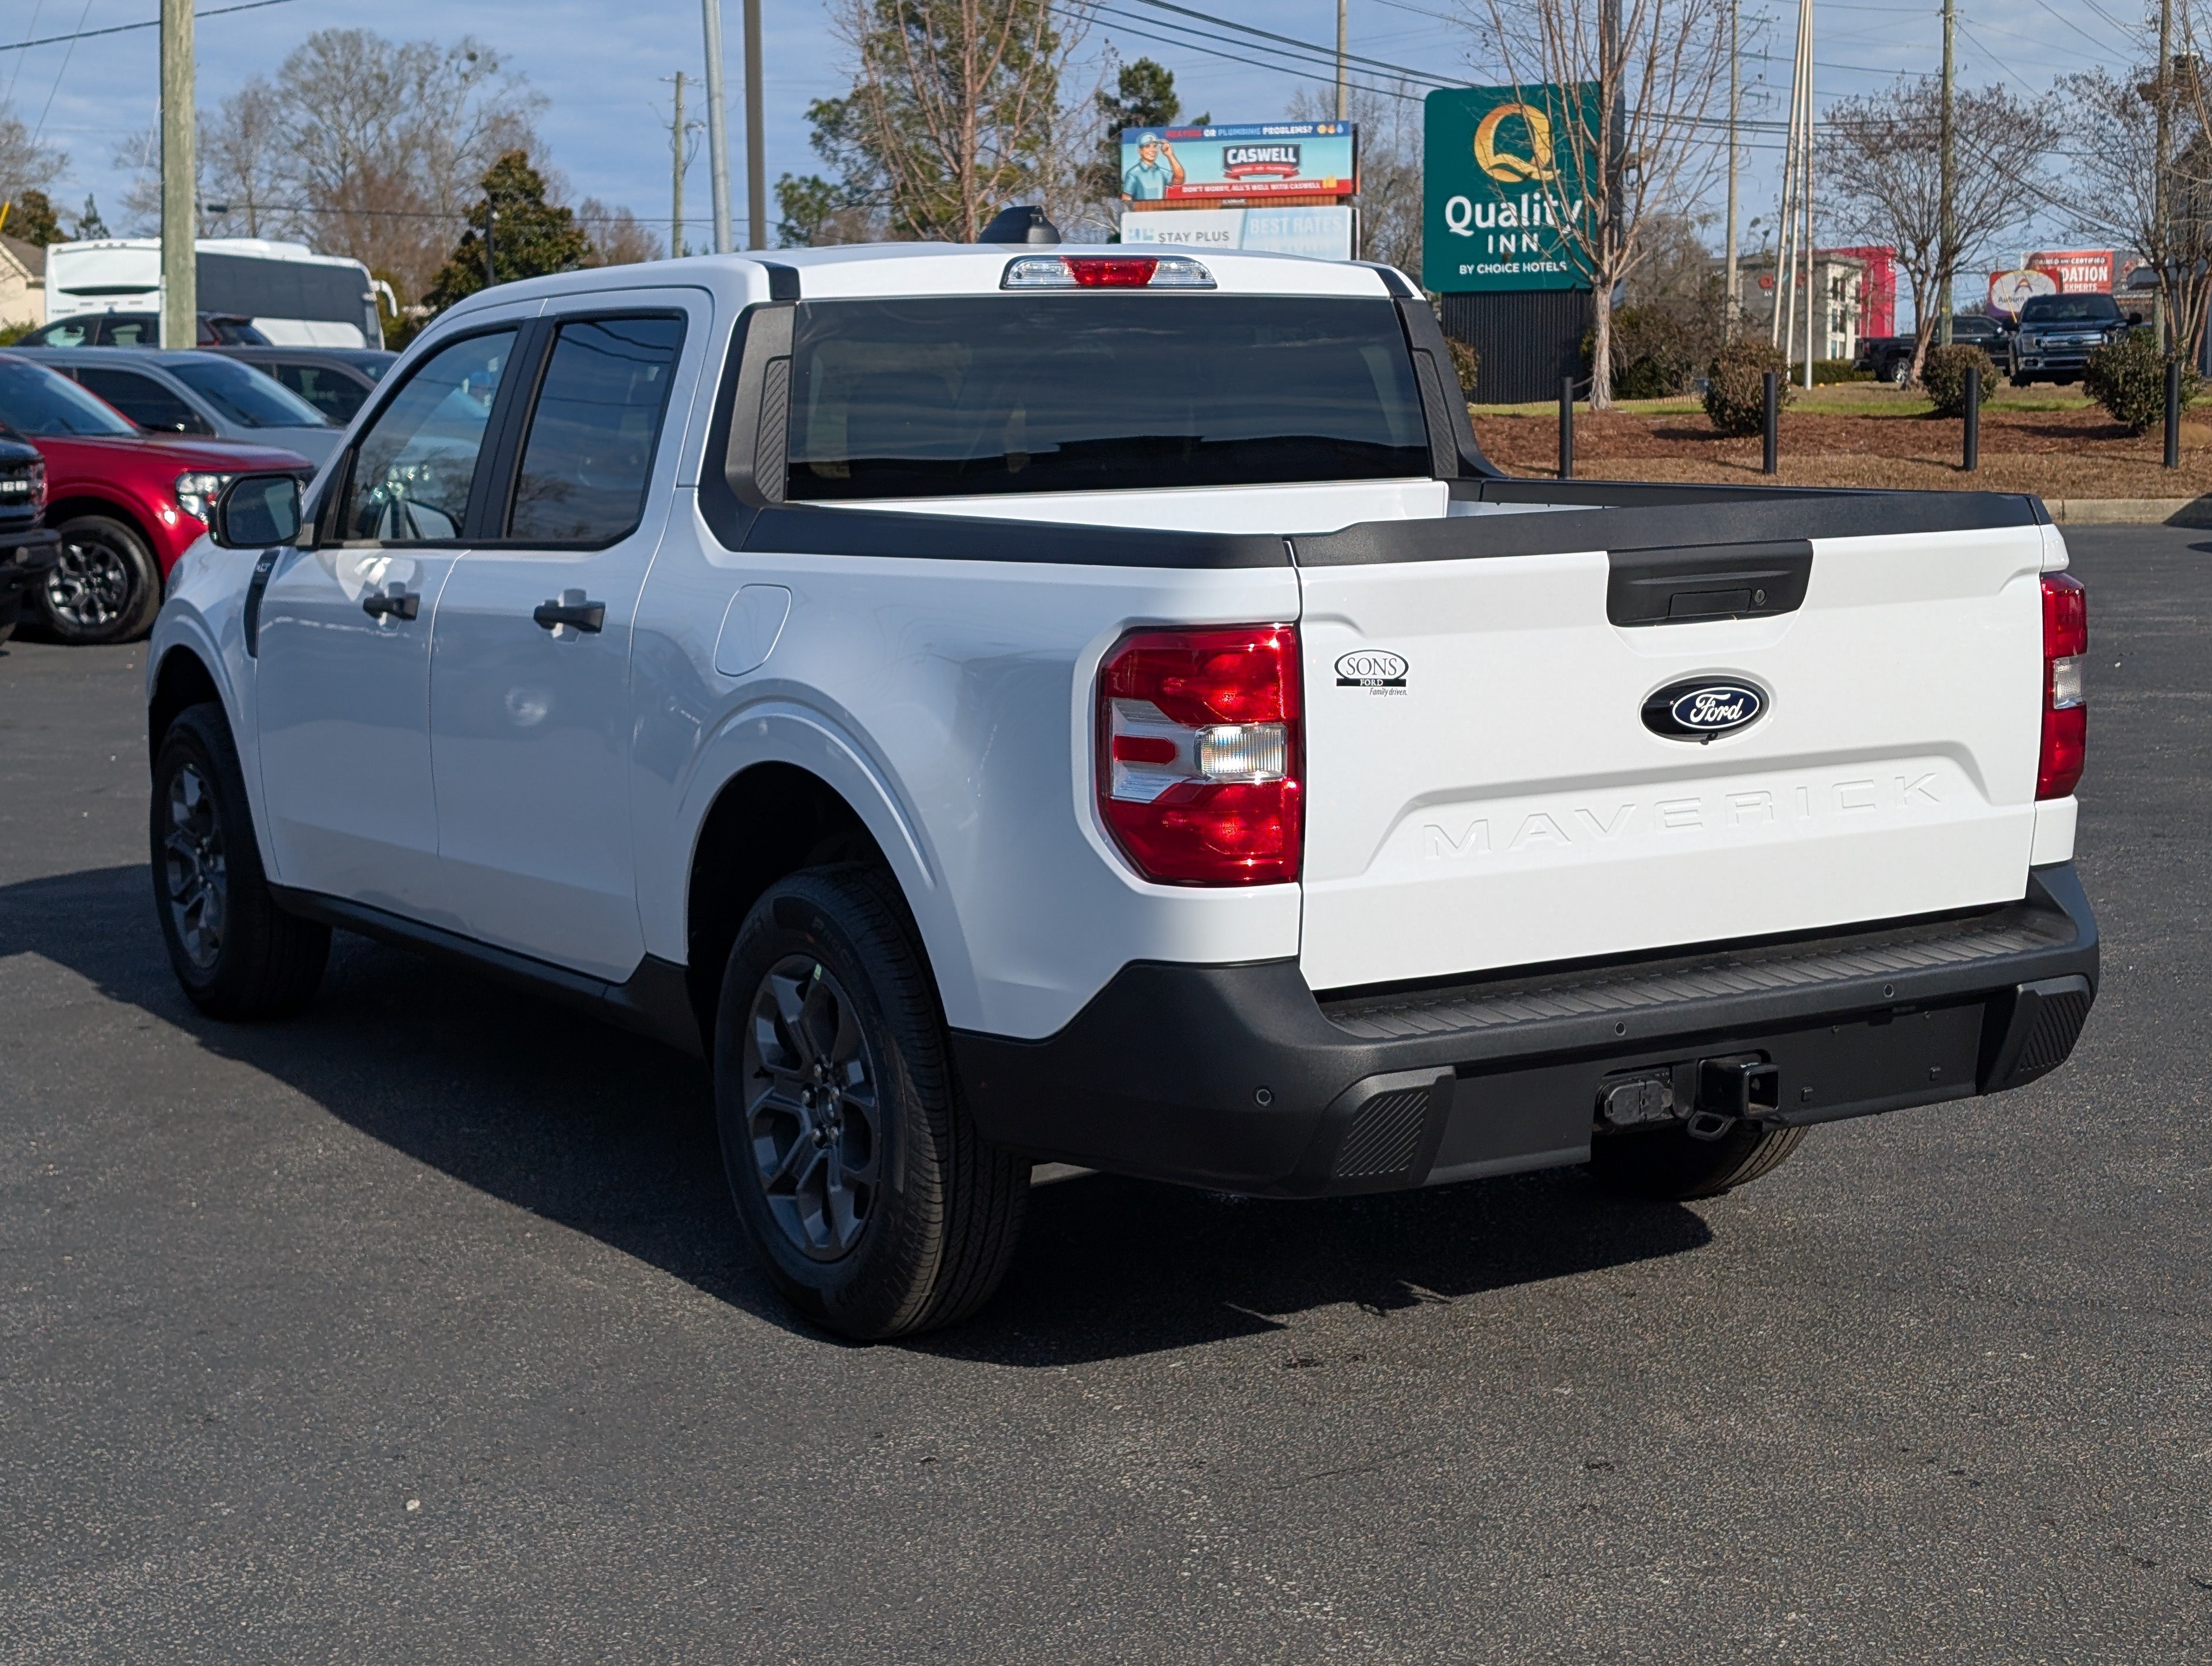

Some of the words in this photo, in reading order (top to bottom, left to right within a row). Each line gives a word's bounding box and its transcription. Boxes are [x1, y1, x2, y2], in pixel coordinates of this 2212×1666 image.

[1227, 147, 1297, 164] CASWELL
[1250, 218, 1288, 234] BEST
[1292, 215, 1344, 233] RATES
[1445, 193, 1583, 237] Quality
[1158, 232, 1191, 243] STAY
[1195, 230, 1230, 242] PLUS
[1488, 233, 1539, 254] INN
[1459, 265, 1474, 275] BY
[1476, 262, 1520, 273] CHOICE
[1522, 261, 1568, 273] HOTELS
[2065, 283, 2098, 293] EXPERTS
[1346, 657, 1397, 676] SONS
[1369, 688, 1388, 697] Family
[1388, 688, 1407, 696] driven.
[1689, 692, 1742, 722] Ford
[1423, 771, 1940, 861] MAVERICK
